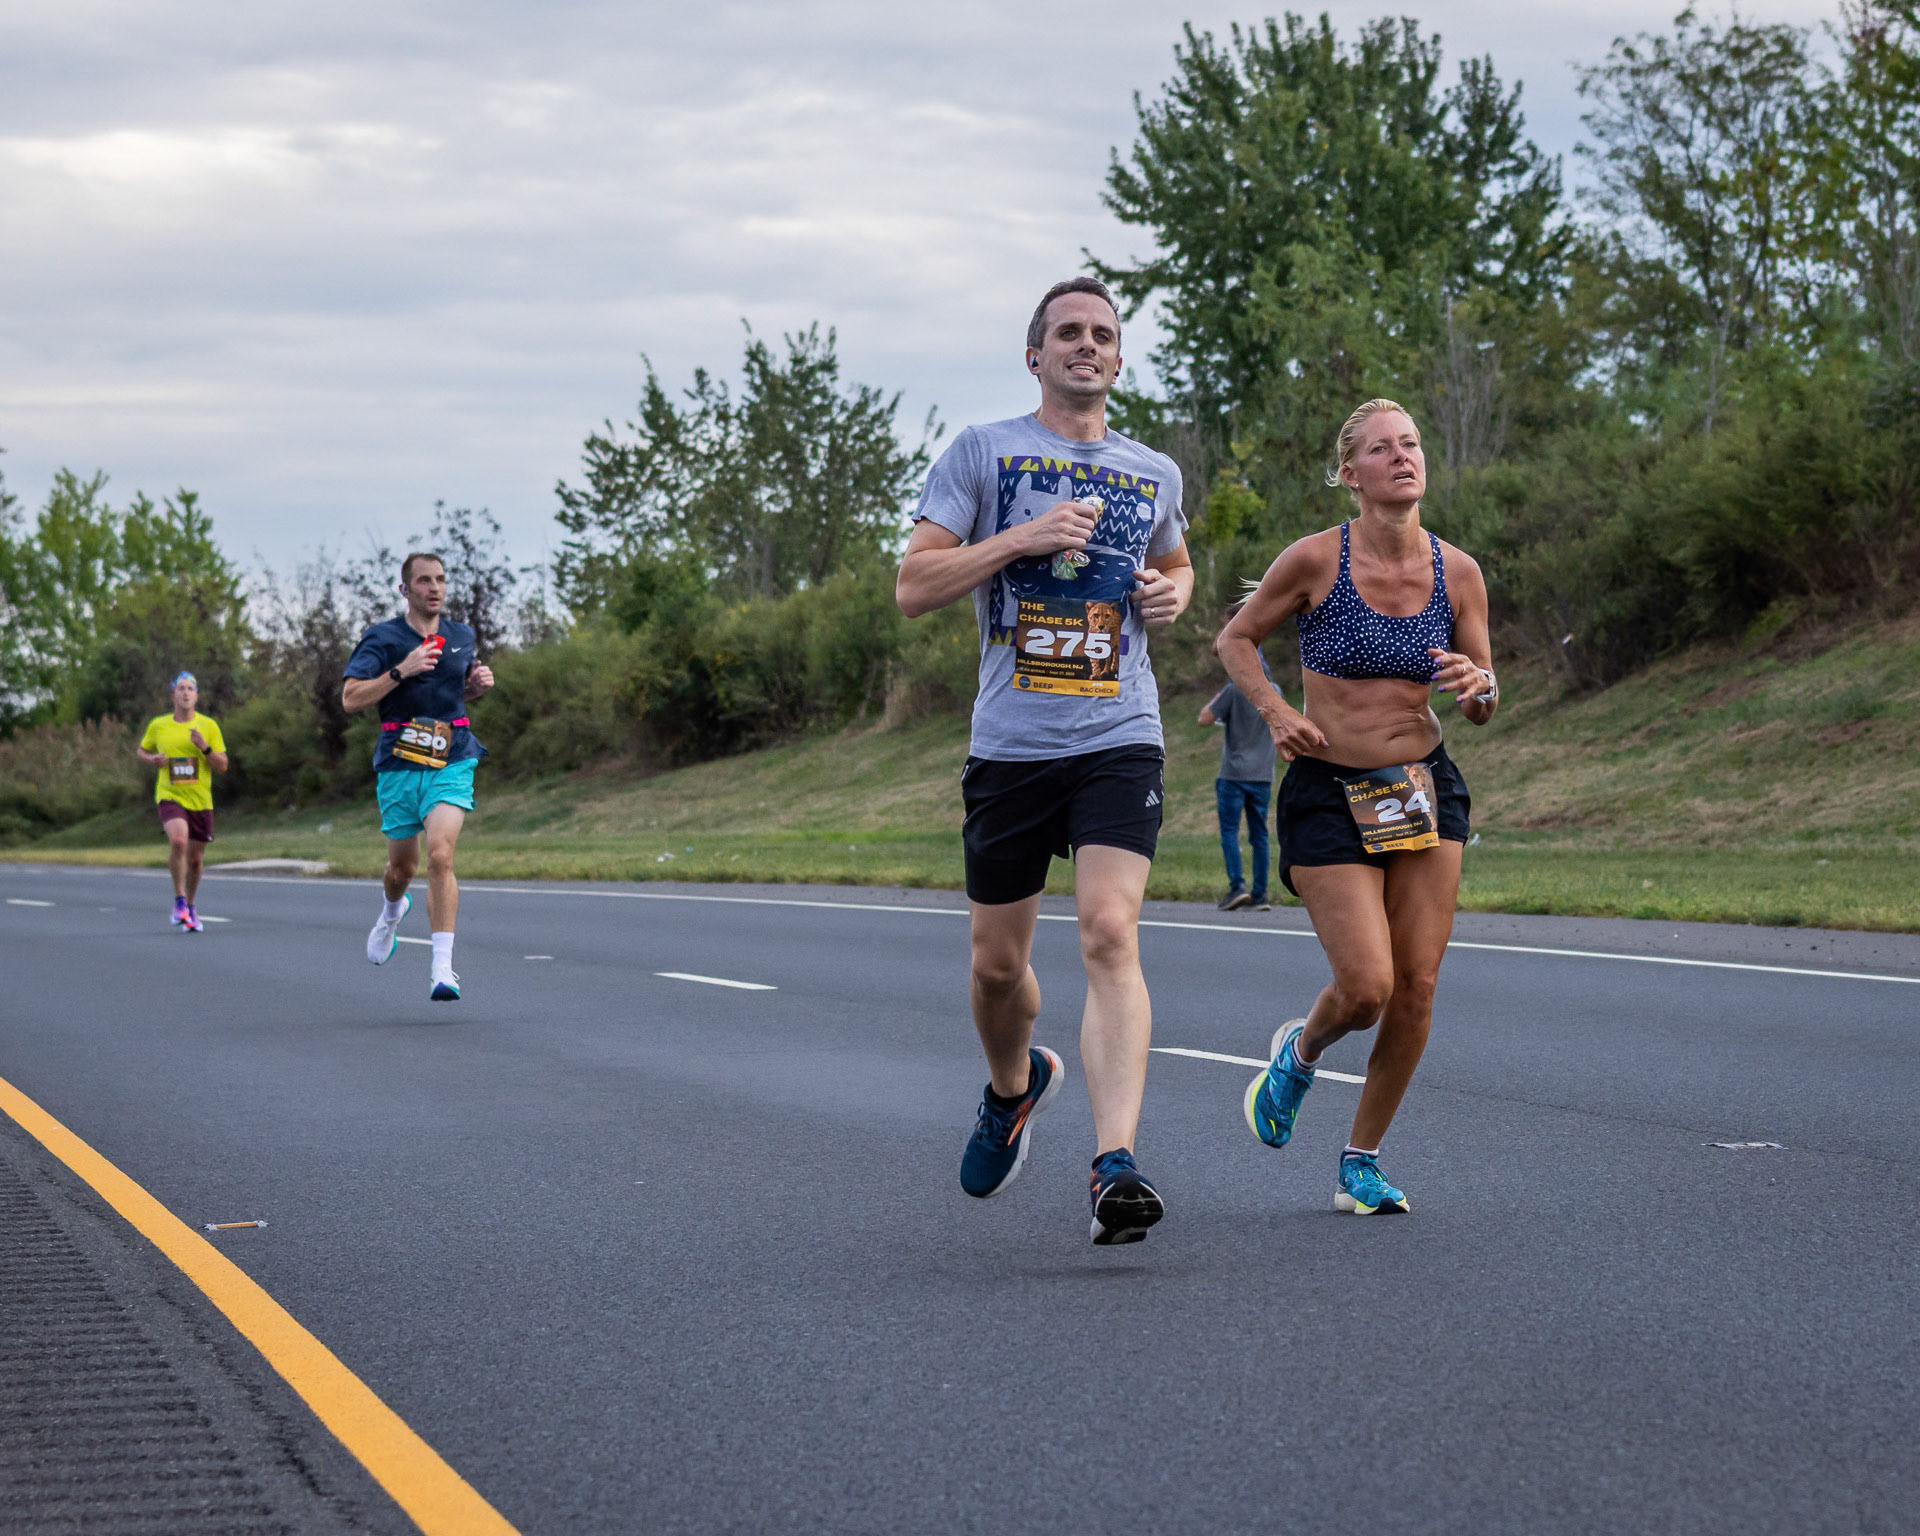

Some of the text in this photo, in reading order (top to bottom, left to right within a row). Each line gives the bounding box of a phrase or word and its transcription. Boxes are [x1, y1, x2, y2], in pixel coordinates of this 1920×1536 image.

[1020, 601, 1045, 611] THE
[1019, 614, 1084, 626] CHASE 5K
[1025, 628, 1112, 659] 275
[401, 727, 447, 750] 230
[1346, 780, 1370, 792] THE
[1350, 781, 1409, 803] CHASE 5K
[1375, 790, 1431, 823] 24
